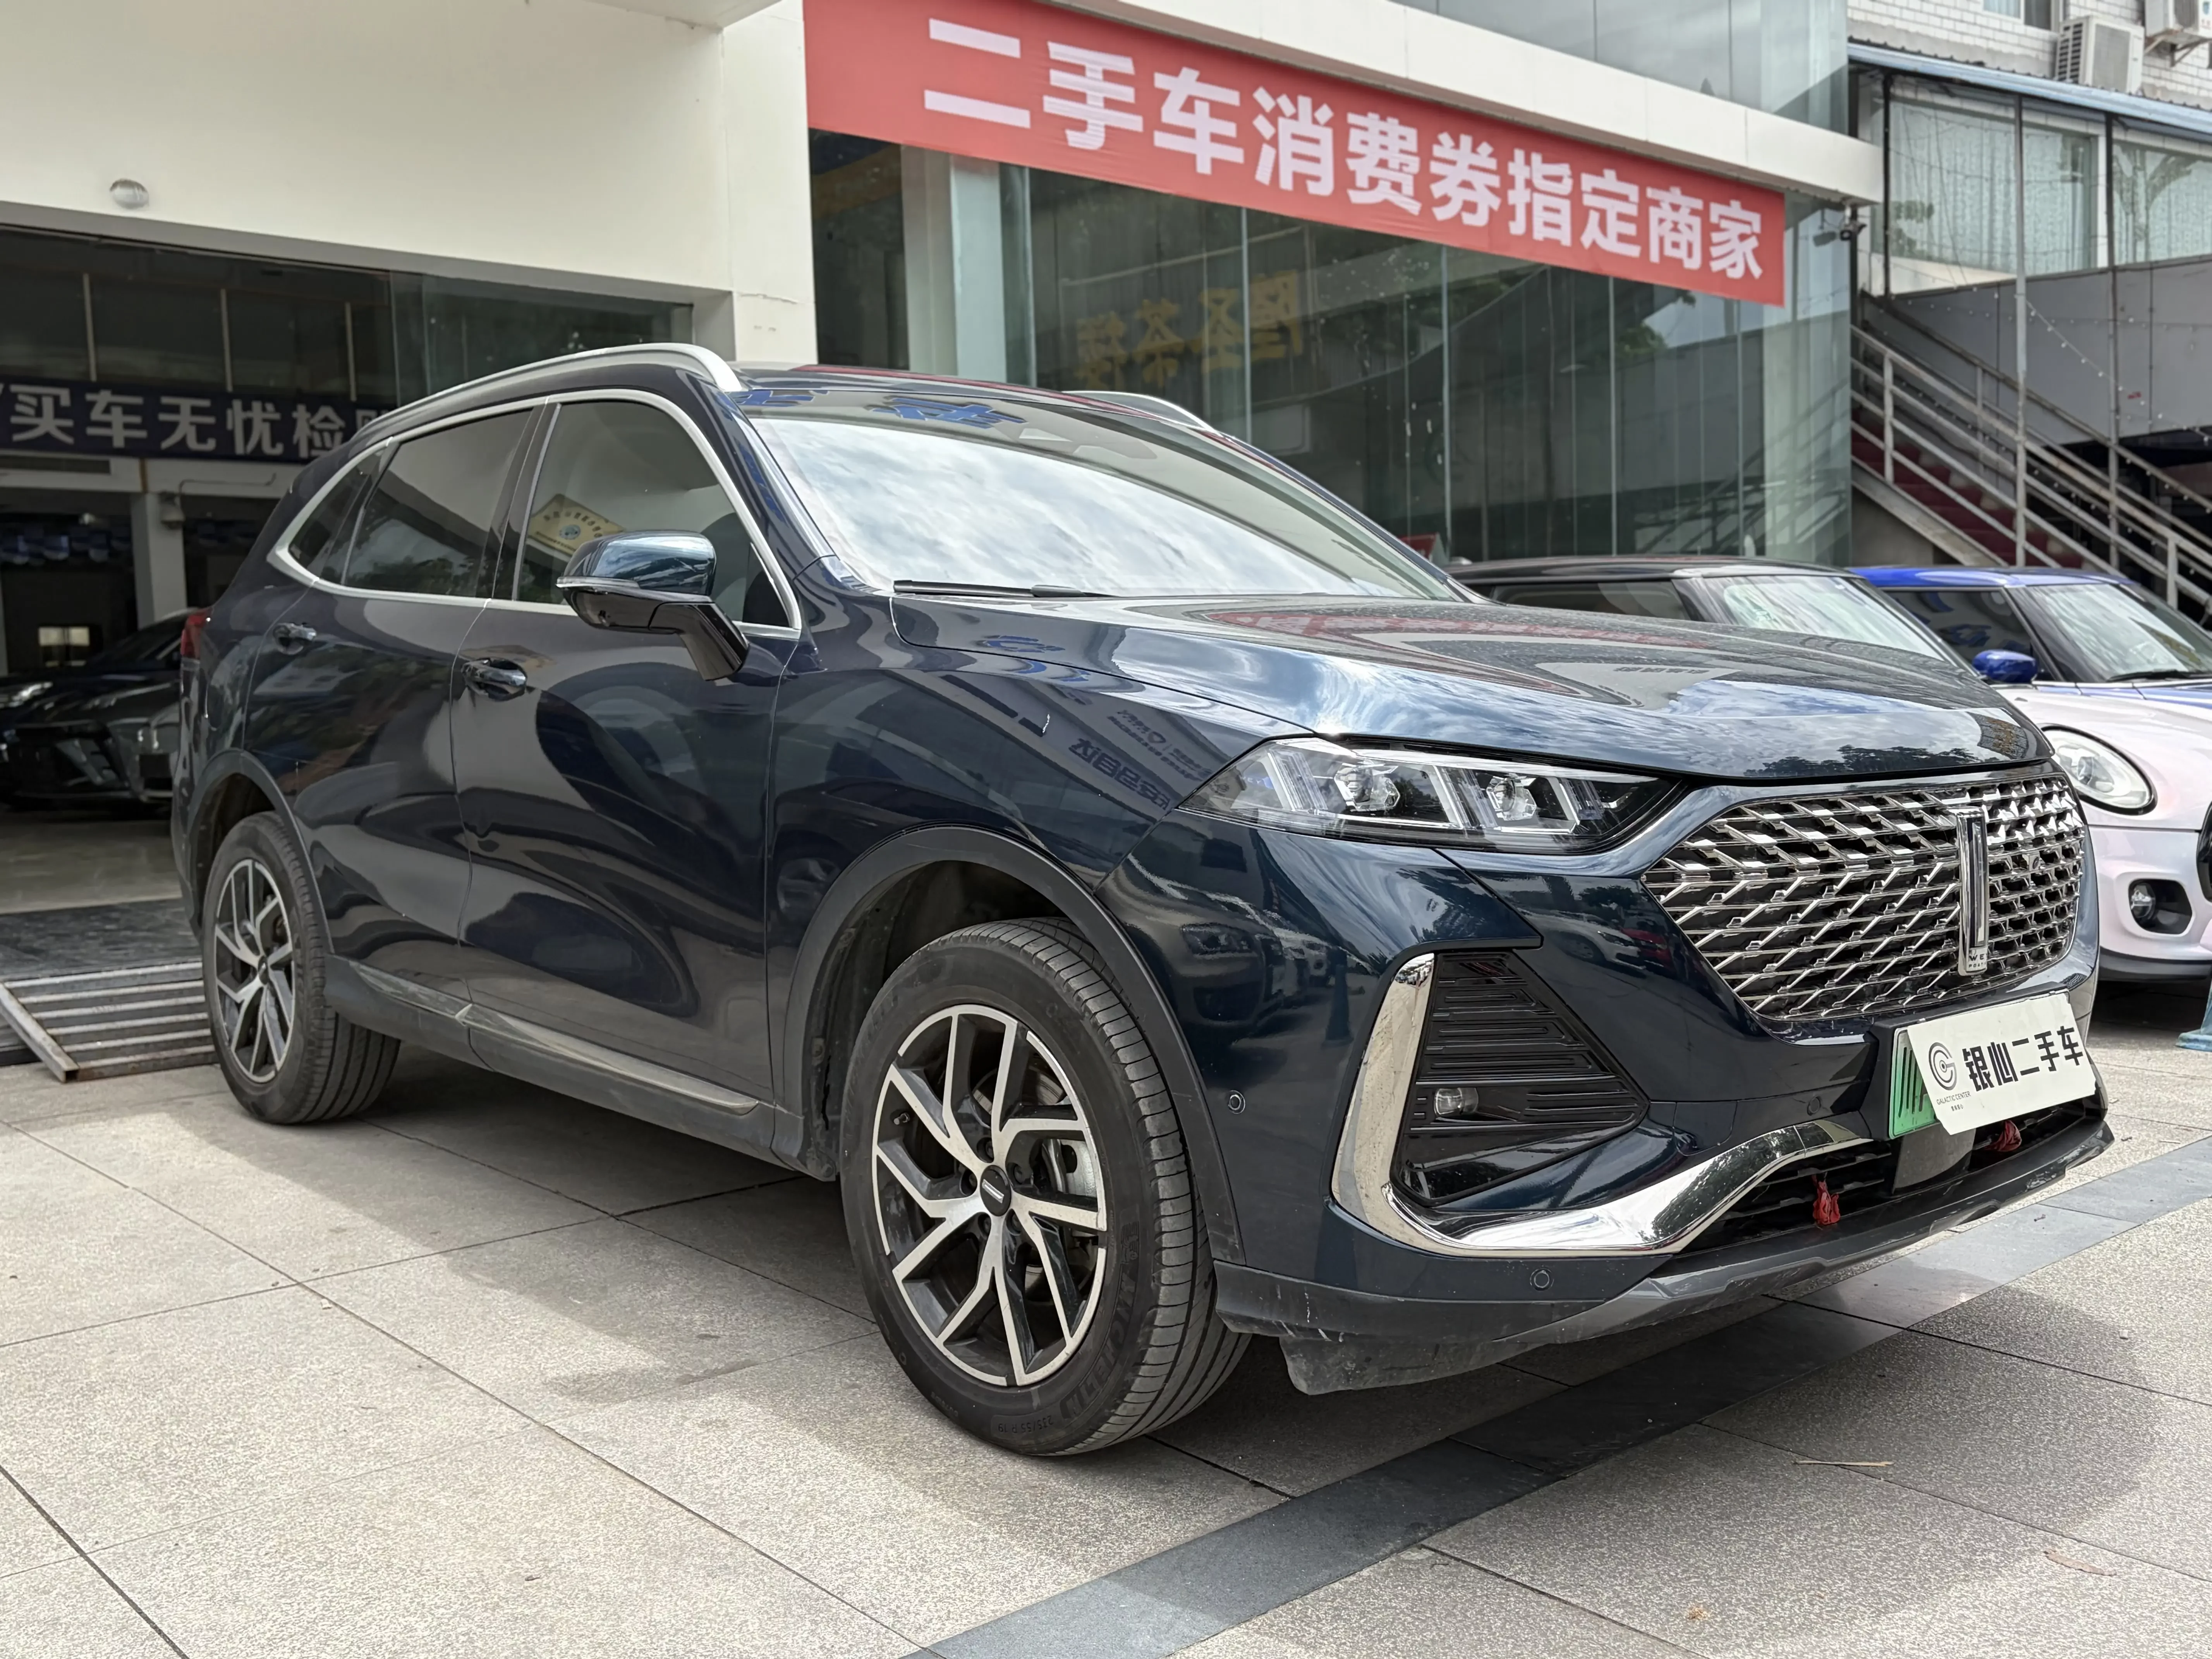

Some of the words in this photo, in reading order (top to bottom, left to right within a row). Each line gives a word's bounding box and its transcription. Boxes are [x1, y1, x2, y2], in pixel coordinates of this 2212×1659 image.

[924, 18, 1763, 280] 二手车消费券指定商家
[0, 384, 391, 459] 买车无忧检
[1962, 1026, 2083, 1092] 银心二手车
[1936, 1095, 1956, 1105] GALACTIC
[1955, 1091, 1971, 1100] CENTER
[998, 1423, 1008, 1432] 19
[1012, 1424, 1018, 1433] R
[1021, 1415, 1054, 1432] 235/55
